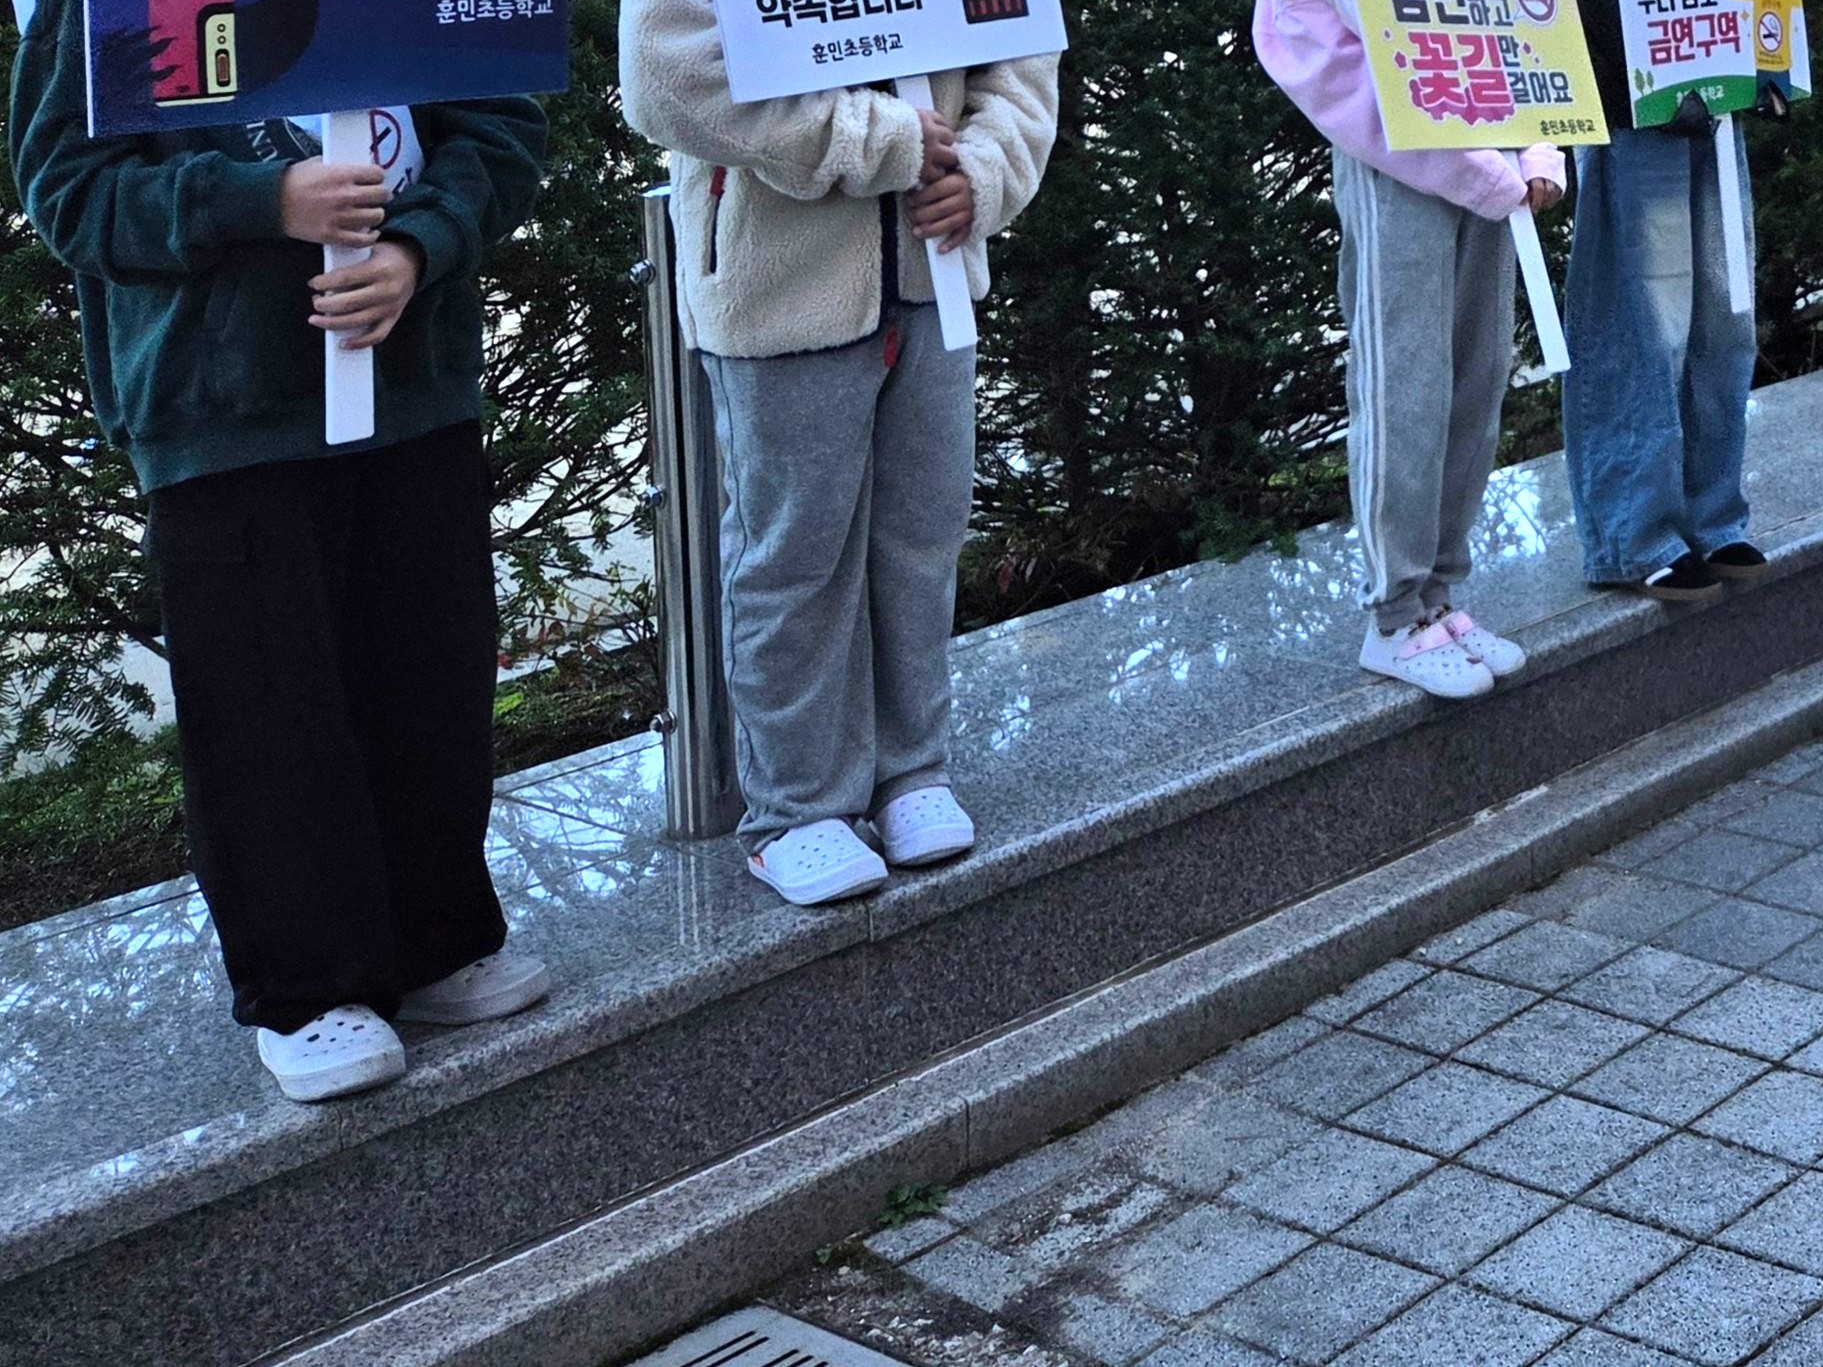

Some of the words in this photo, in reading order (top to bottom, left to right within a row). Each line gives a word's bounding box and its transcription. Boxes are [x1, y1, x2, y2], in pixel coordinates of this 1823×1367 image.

[811, 33, 904, 64] 훈민초등학교
[1647, 11, 1741, 66] 금연구역
[1407, 31, 1520, 106] 꽃길만
[1507, 70, 1574, 104] 걸어요
